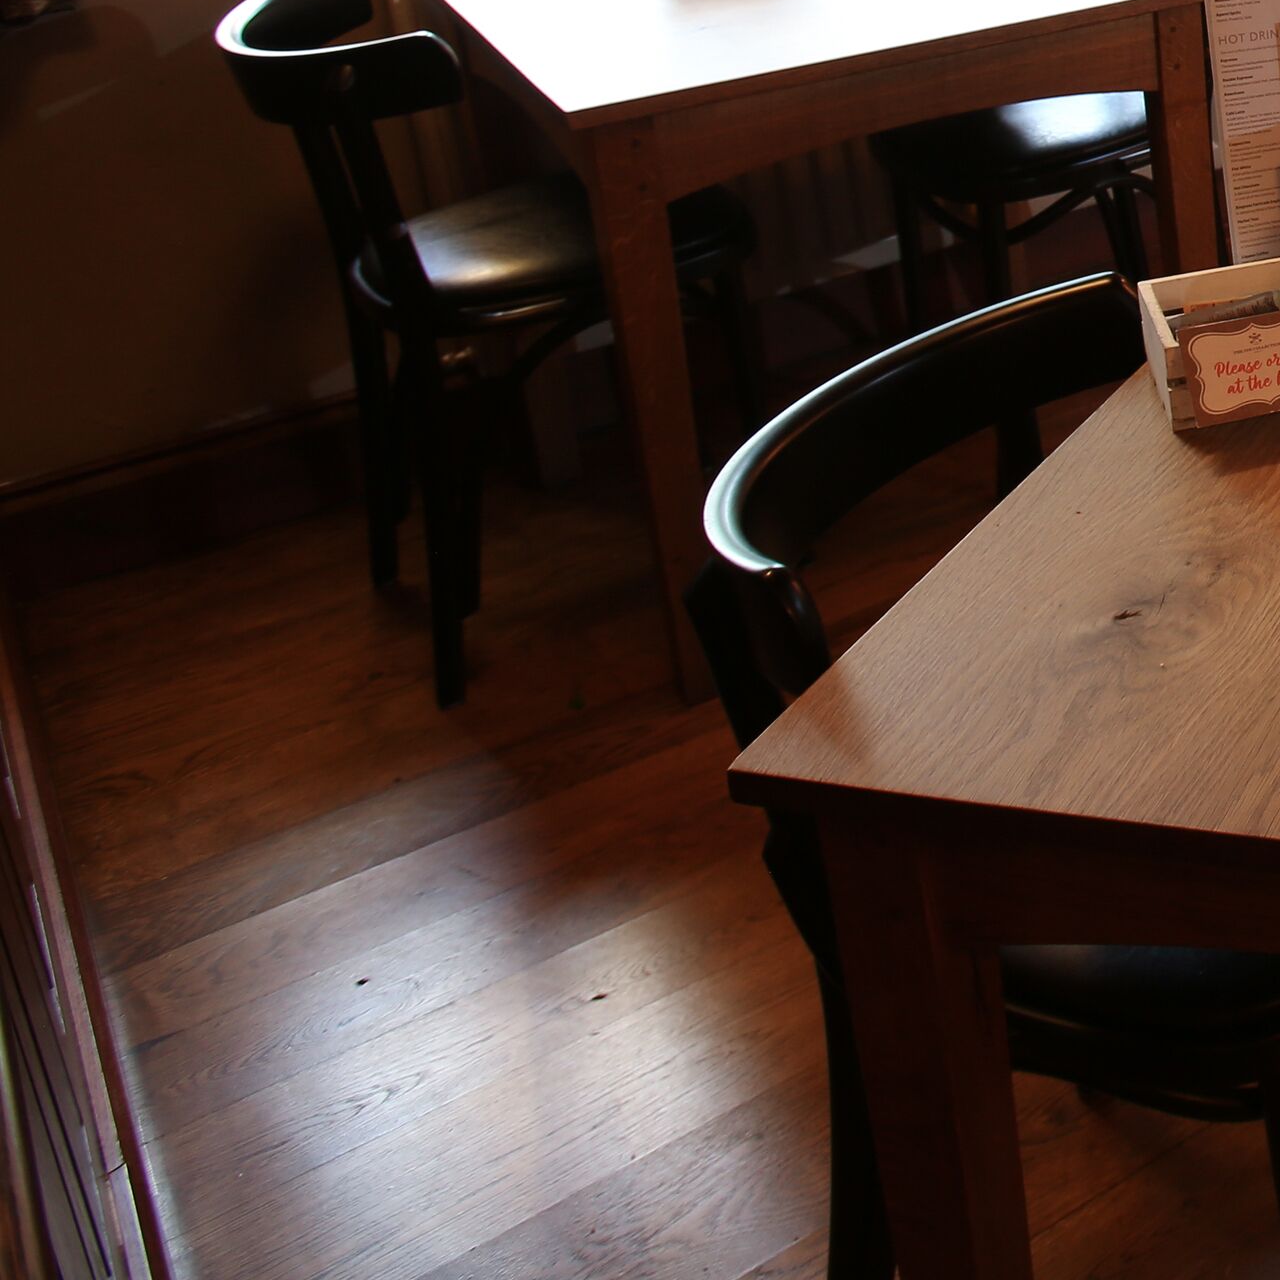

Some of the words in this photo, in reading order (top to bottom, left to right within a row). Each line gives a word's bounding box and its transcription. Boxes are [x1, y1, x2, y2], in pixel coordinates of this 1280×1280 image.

[1217, 32, 1246, 46] HOT
[1249, 28, 1280, 42] DRIN
[1213, 359, 1263, 378] Please
[1227, 379, 1245, 394] at
[1245, 373, 1272, 392] the
